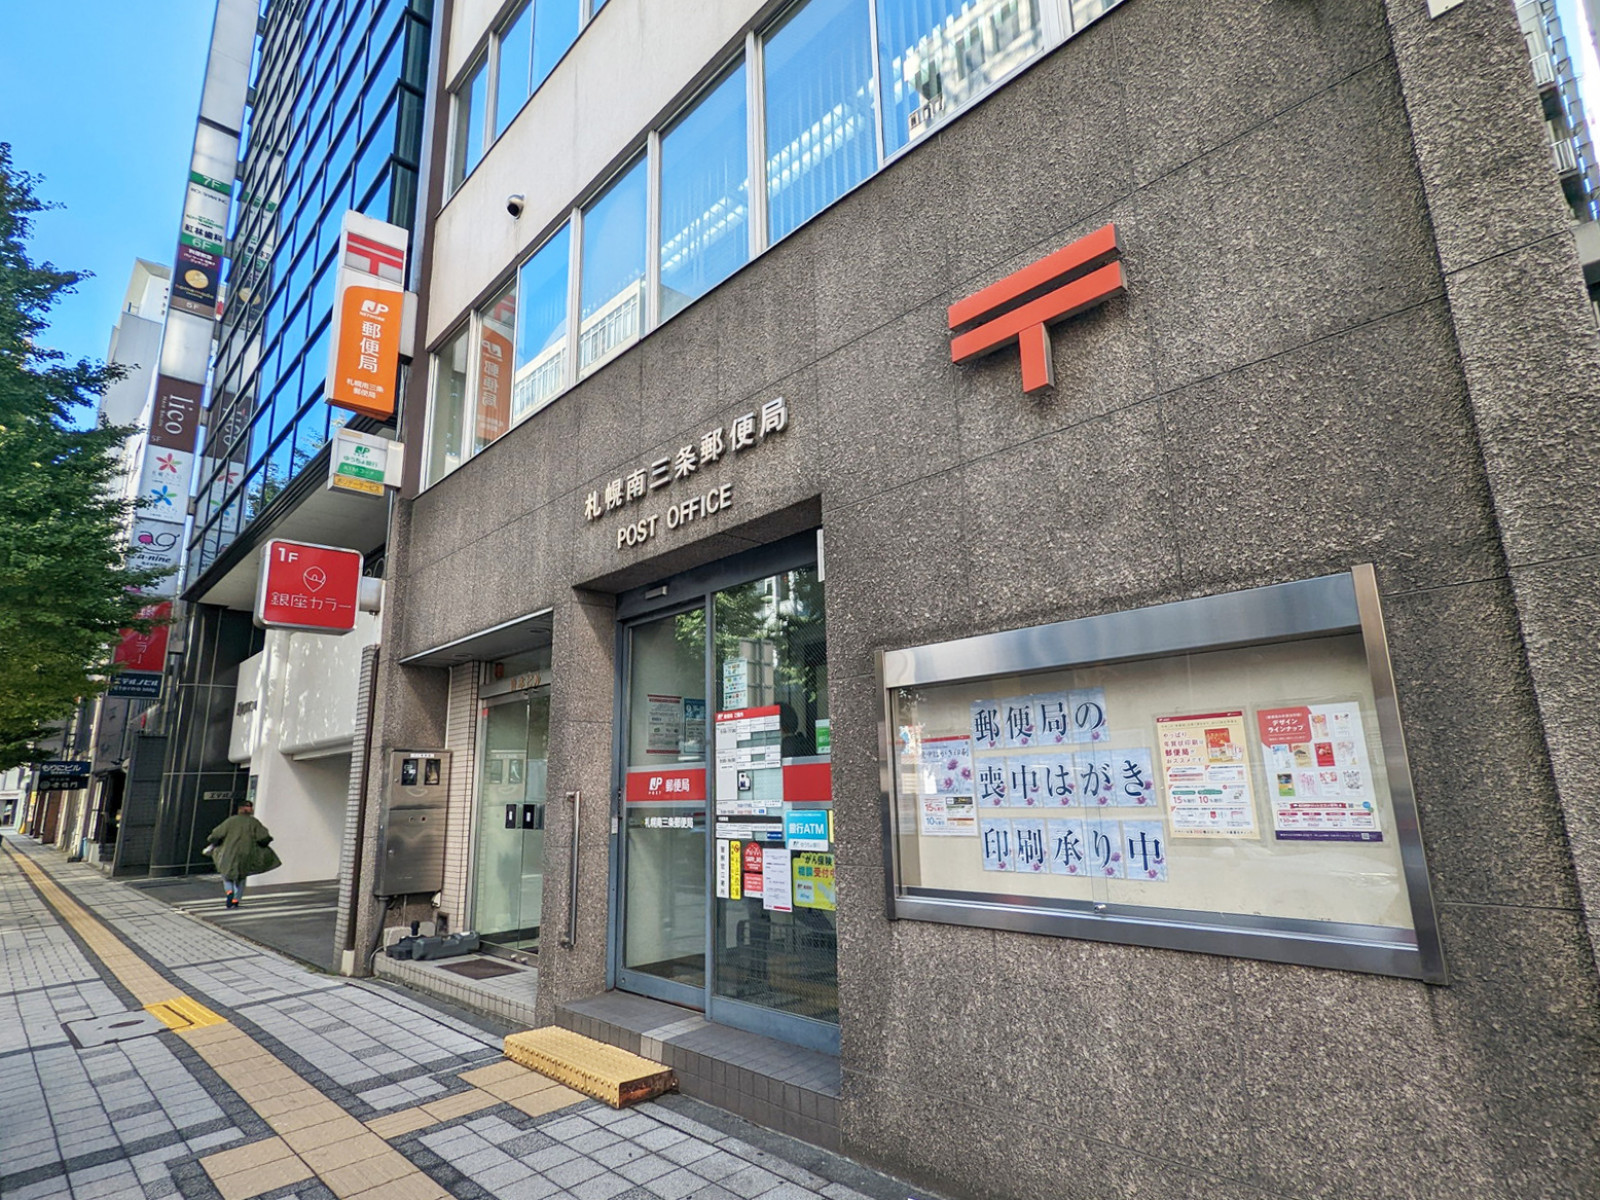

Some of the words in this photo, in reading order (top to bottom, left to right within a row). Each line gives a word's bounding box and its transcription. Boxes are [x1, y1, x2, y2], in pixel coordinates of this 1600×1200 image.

[203, 174, 222, 188] 7F
[192, 237, 213, 250] 6F
[358, 321, 381, 373] 郵便局
[353, 387, 377, 399] 郵便局
[165, 394, 194, 435] lico
[583, 396, 789, 522] 札幌南三条郵便局
[617, 514, 659, 549] POST
[666, 482, 733, 529] OFFICE
[278, 547, 299, 563] 1F
[270, 591, 352, 612] 銀座カラー
[974, 701, 1104, 743] 郵便局の
[1267, 725, 1304, 734] ラインナップ
[1271, 718, 1298, 727] デザイン
[665, 777, 690, 792] 郵便局
[979, 759, 1145, 801] 喪中はがき
[983, 827, 1162, 872] 印刷承り中
